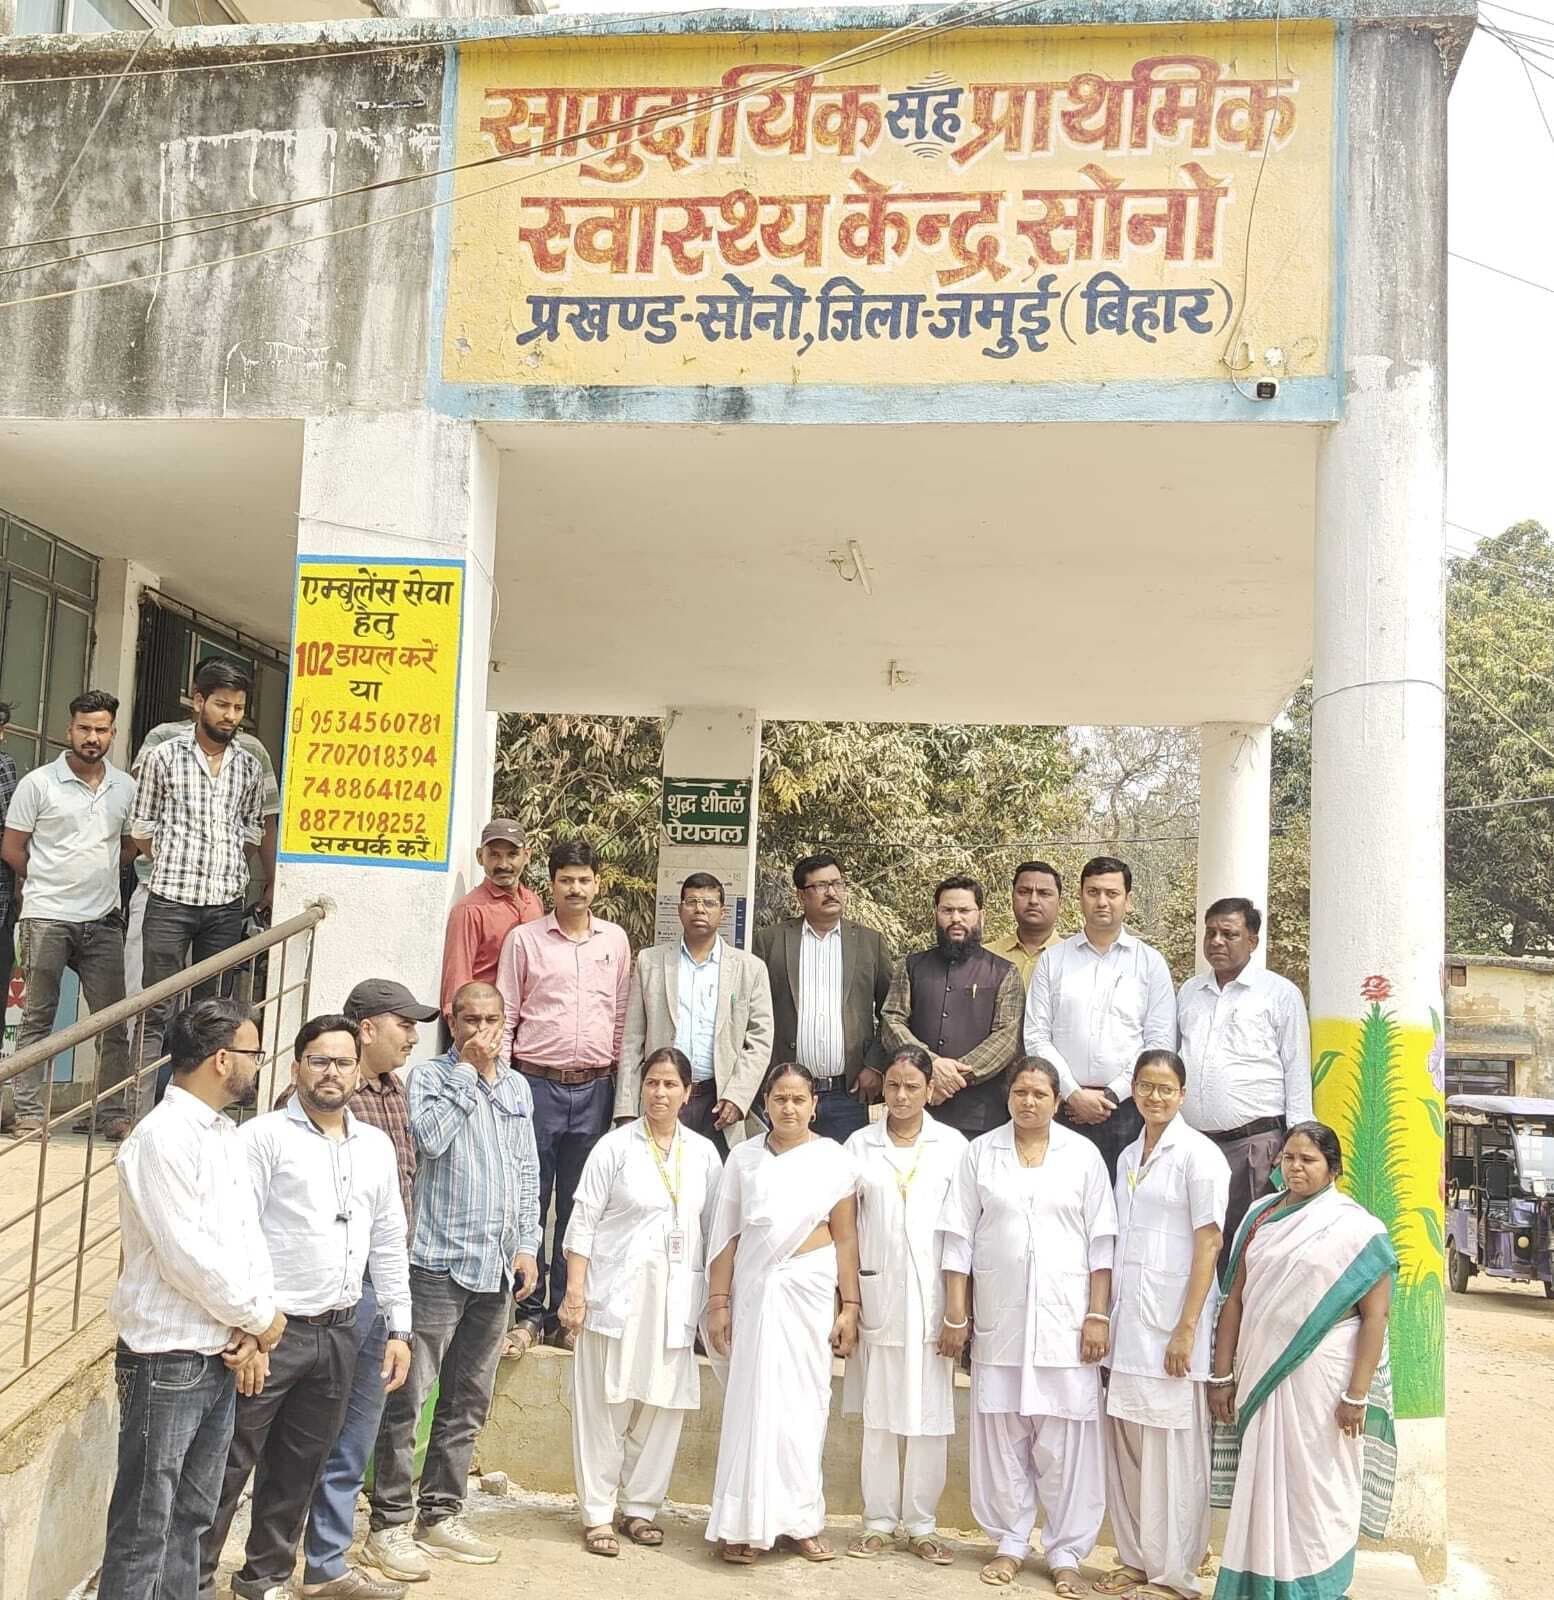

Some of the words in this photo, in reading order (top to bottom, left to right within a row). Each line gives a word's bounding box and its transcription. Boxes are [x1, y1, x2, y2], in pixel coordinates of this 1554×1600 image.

[479, 63, 882, 183] सामुदायिक
[885, 87, 965, 143] सह
[951, 55, 1298, 166] प्राथमिक
[519, 189, 831, 275] स्वास्थ्य
[1016, 161, 1229, 266] सोनो
[1060, 271, 1234, 346] (बिहार)
[301, 567, 399, 612] एम्बुलेंस
[402, 568, 455, 607] सेवा
[353, 605, 399, 640] हेतु
[296, 641, 334, 677] 102
[335, 644, 398, 675] डायल
[398, 638, 439, 674] करें
[349, 680, 383, 703] या
[310, 709, 442, 736] 9534560781
[306, 742, 438, 768] 7707018394
[303, 776, 442, 802] 7488641240
[667, 793, 698, 818] शुद्ध
[299, 808, 427, 835] 8877198252
[667, 818, 745, 843] पेयजल
[310, 833, 392, 857] सम्पर्क
